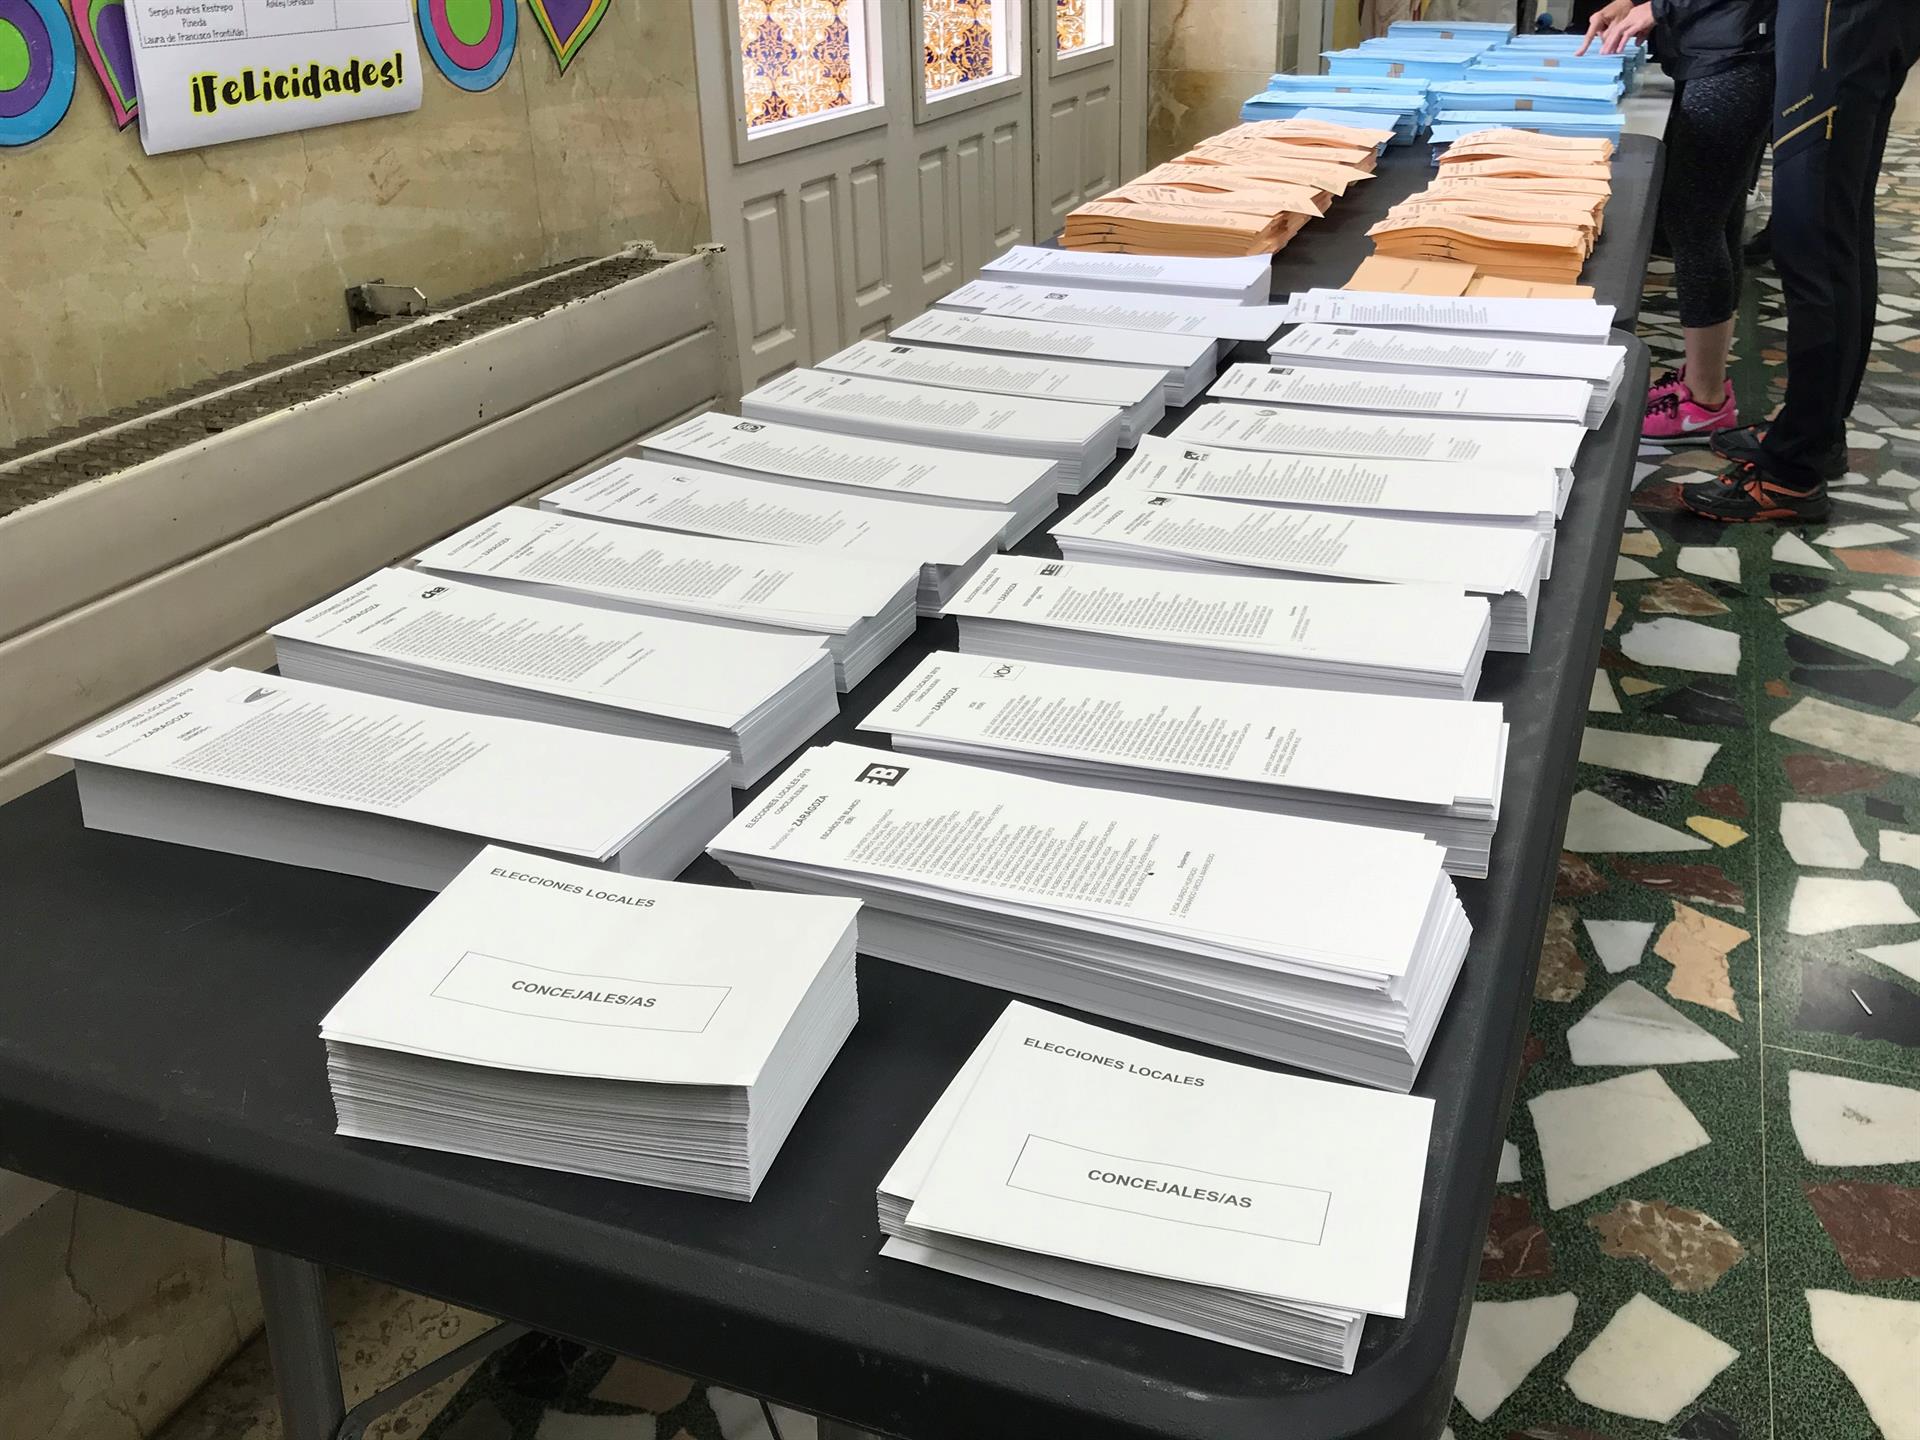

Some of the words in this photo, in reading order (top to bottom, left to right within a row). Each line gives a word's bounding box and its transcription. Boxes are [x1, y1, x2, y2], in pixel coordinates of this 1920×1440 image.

[147, 7, 174, 19] Sergio
[201, 3, 234, 14] Restrepo
[181, 18, 207, 28] Pineda
[143, 35, 166, 45] Laura
[166, 33, 176, 43] de
[177, 31, 212, 41] Francisco
[993, 664, 1013, 677] VOX
[743, 798, 780, 828] ELECCIONES
[774, 777, 801, 799] LOCALES
[795, 767, 812, 778] 2019
[791, 794, 829, 827] ZARAGOZA
[490, 867, 584, 895] ELECCIONES
[585, 888, 656, 908] LOCALES
[510, 979, 658, 1009] CONCEJALES/AS
[1023, 1037, 1126, 1070] ELECCIONES
[1127, 1063, 1206, 1088] LOCALES
[1087, 1168, 1254, 1209] CONCEJALES/AS
